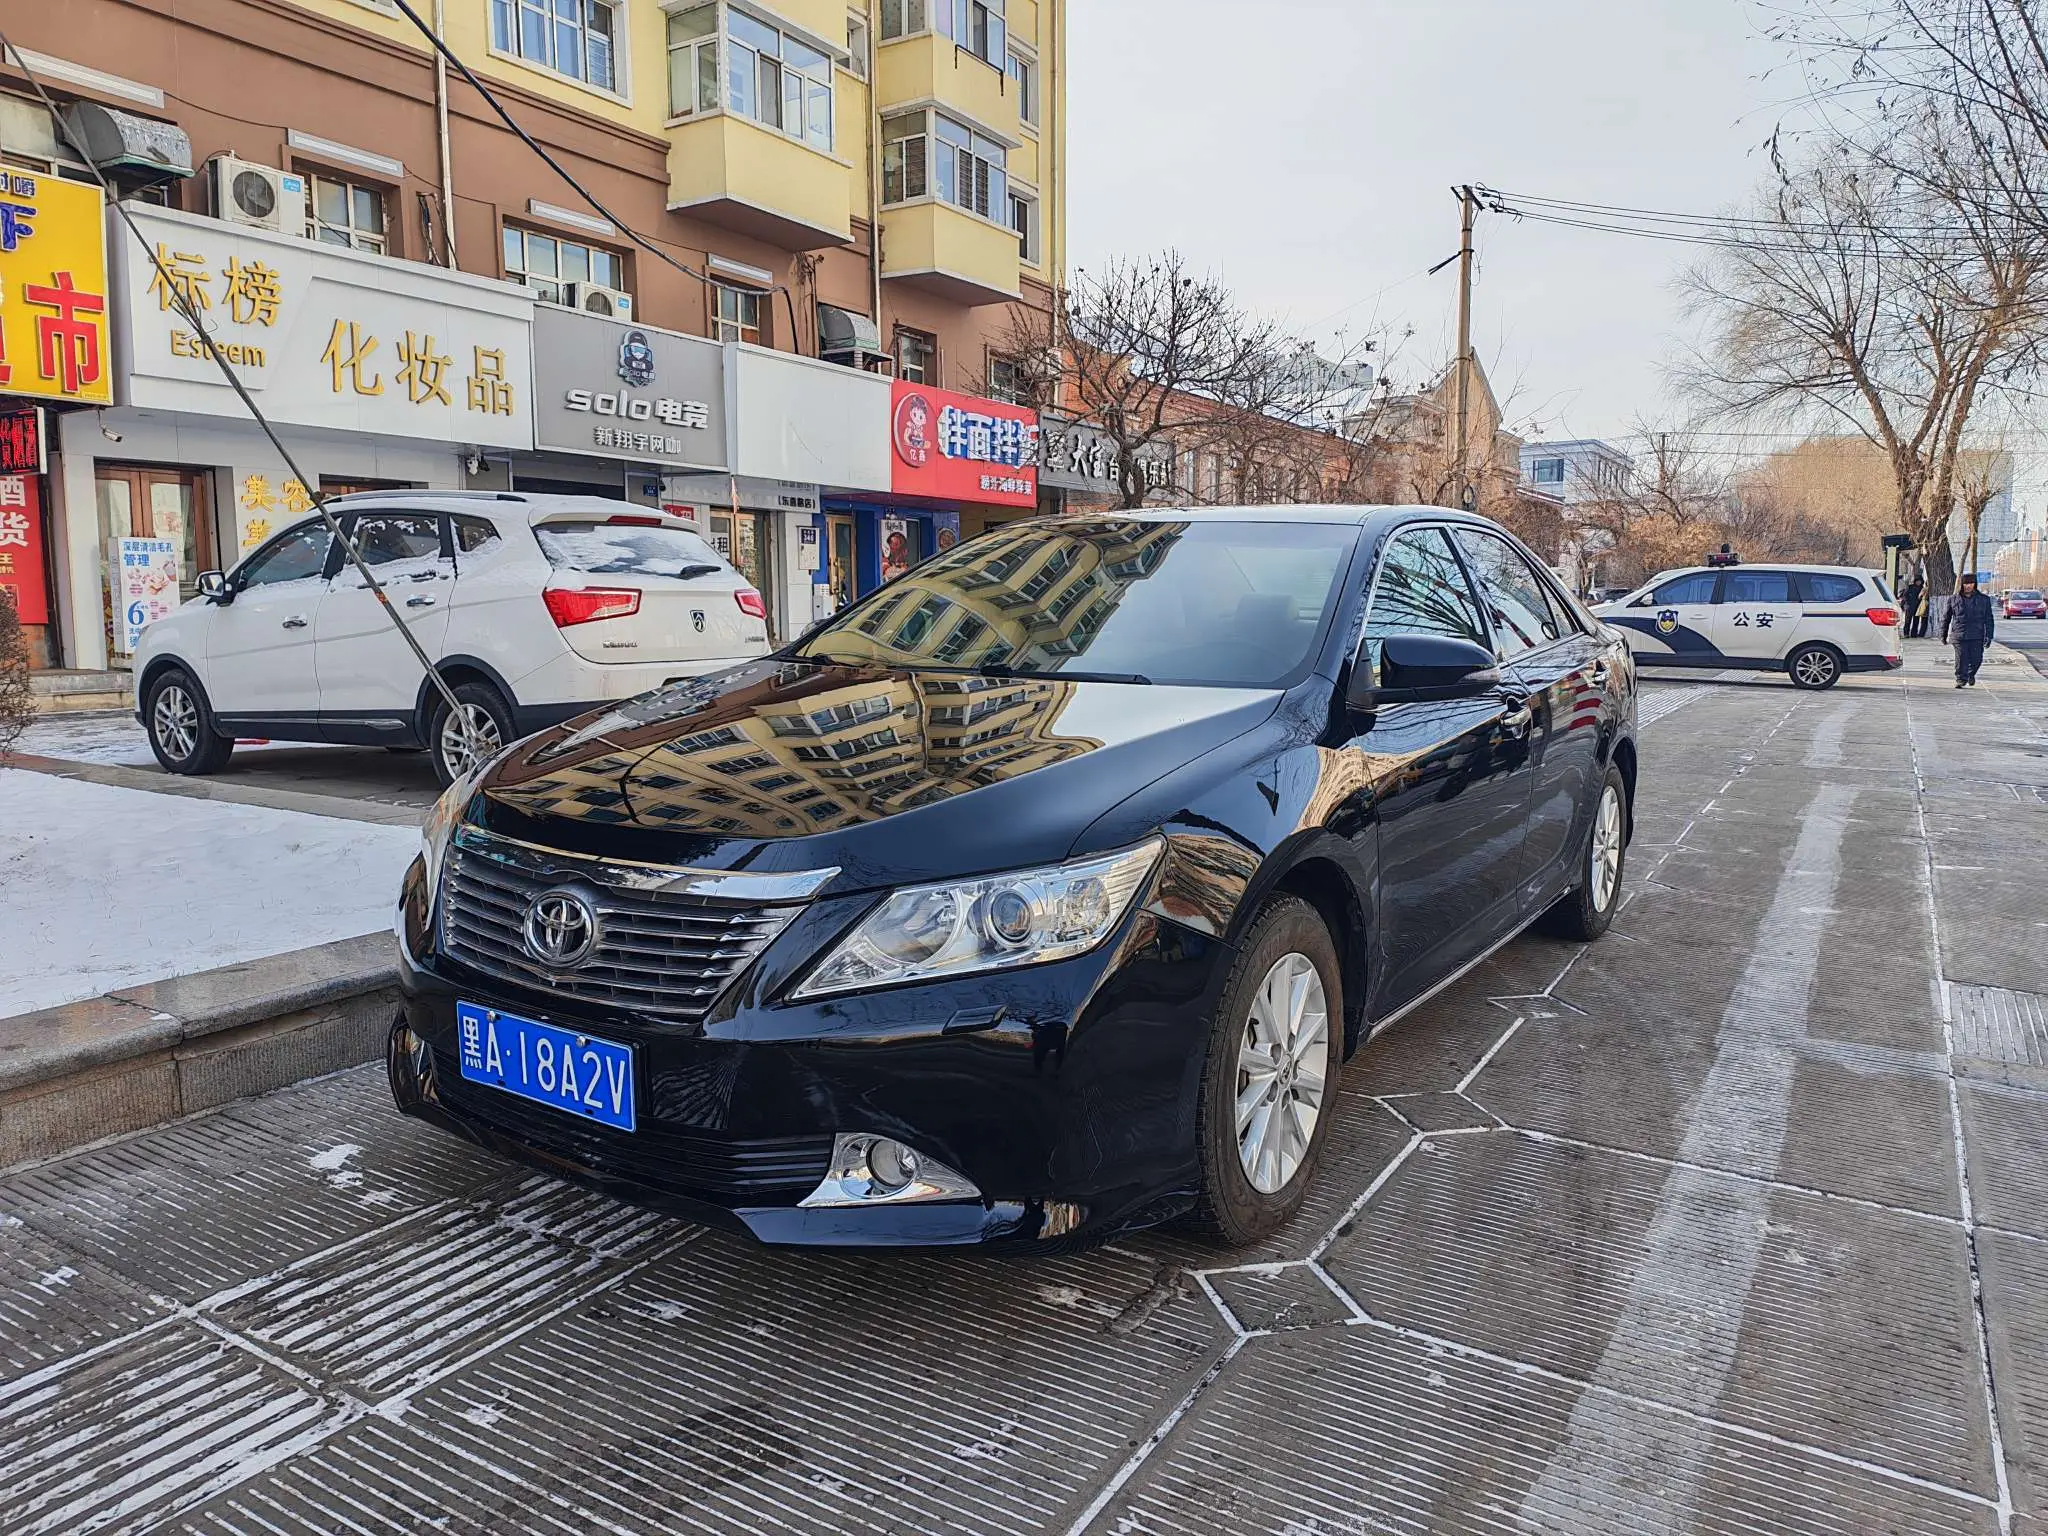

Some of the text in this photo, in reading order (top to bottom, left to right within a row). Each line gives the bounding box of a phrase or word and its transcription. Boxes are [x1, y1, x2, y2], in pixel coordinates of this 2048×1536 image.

[147, 242, 282, 327] 标榜
[320, 318, 514, 416] 化妆品
[565, 388, 709, 429] solo 电竞
[594, 426, 682, 455] 新翔宇网咖
[124, 553, 150, 567] 管理
[127, 600, 145, 626] 6
[1733, 611, 1774, 629] 公安
[462, 1015, 626, 1115] 黑A·18A2V
